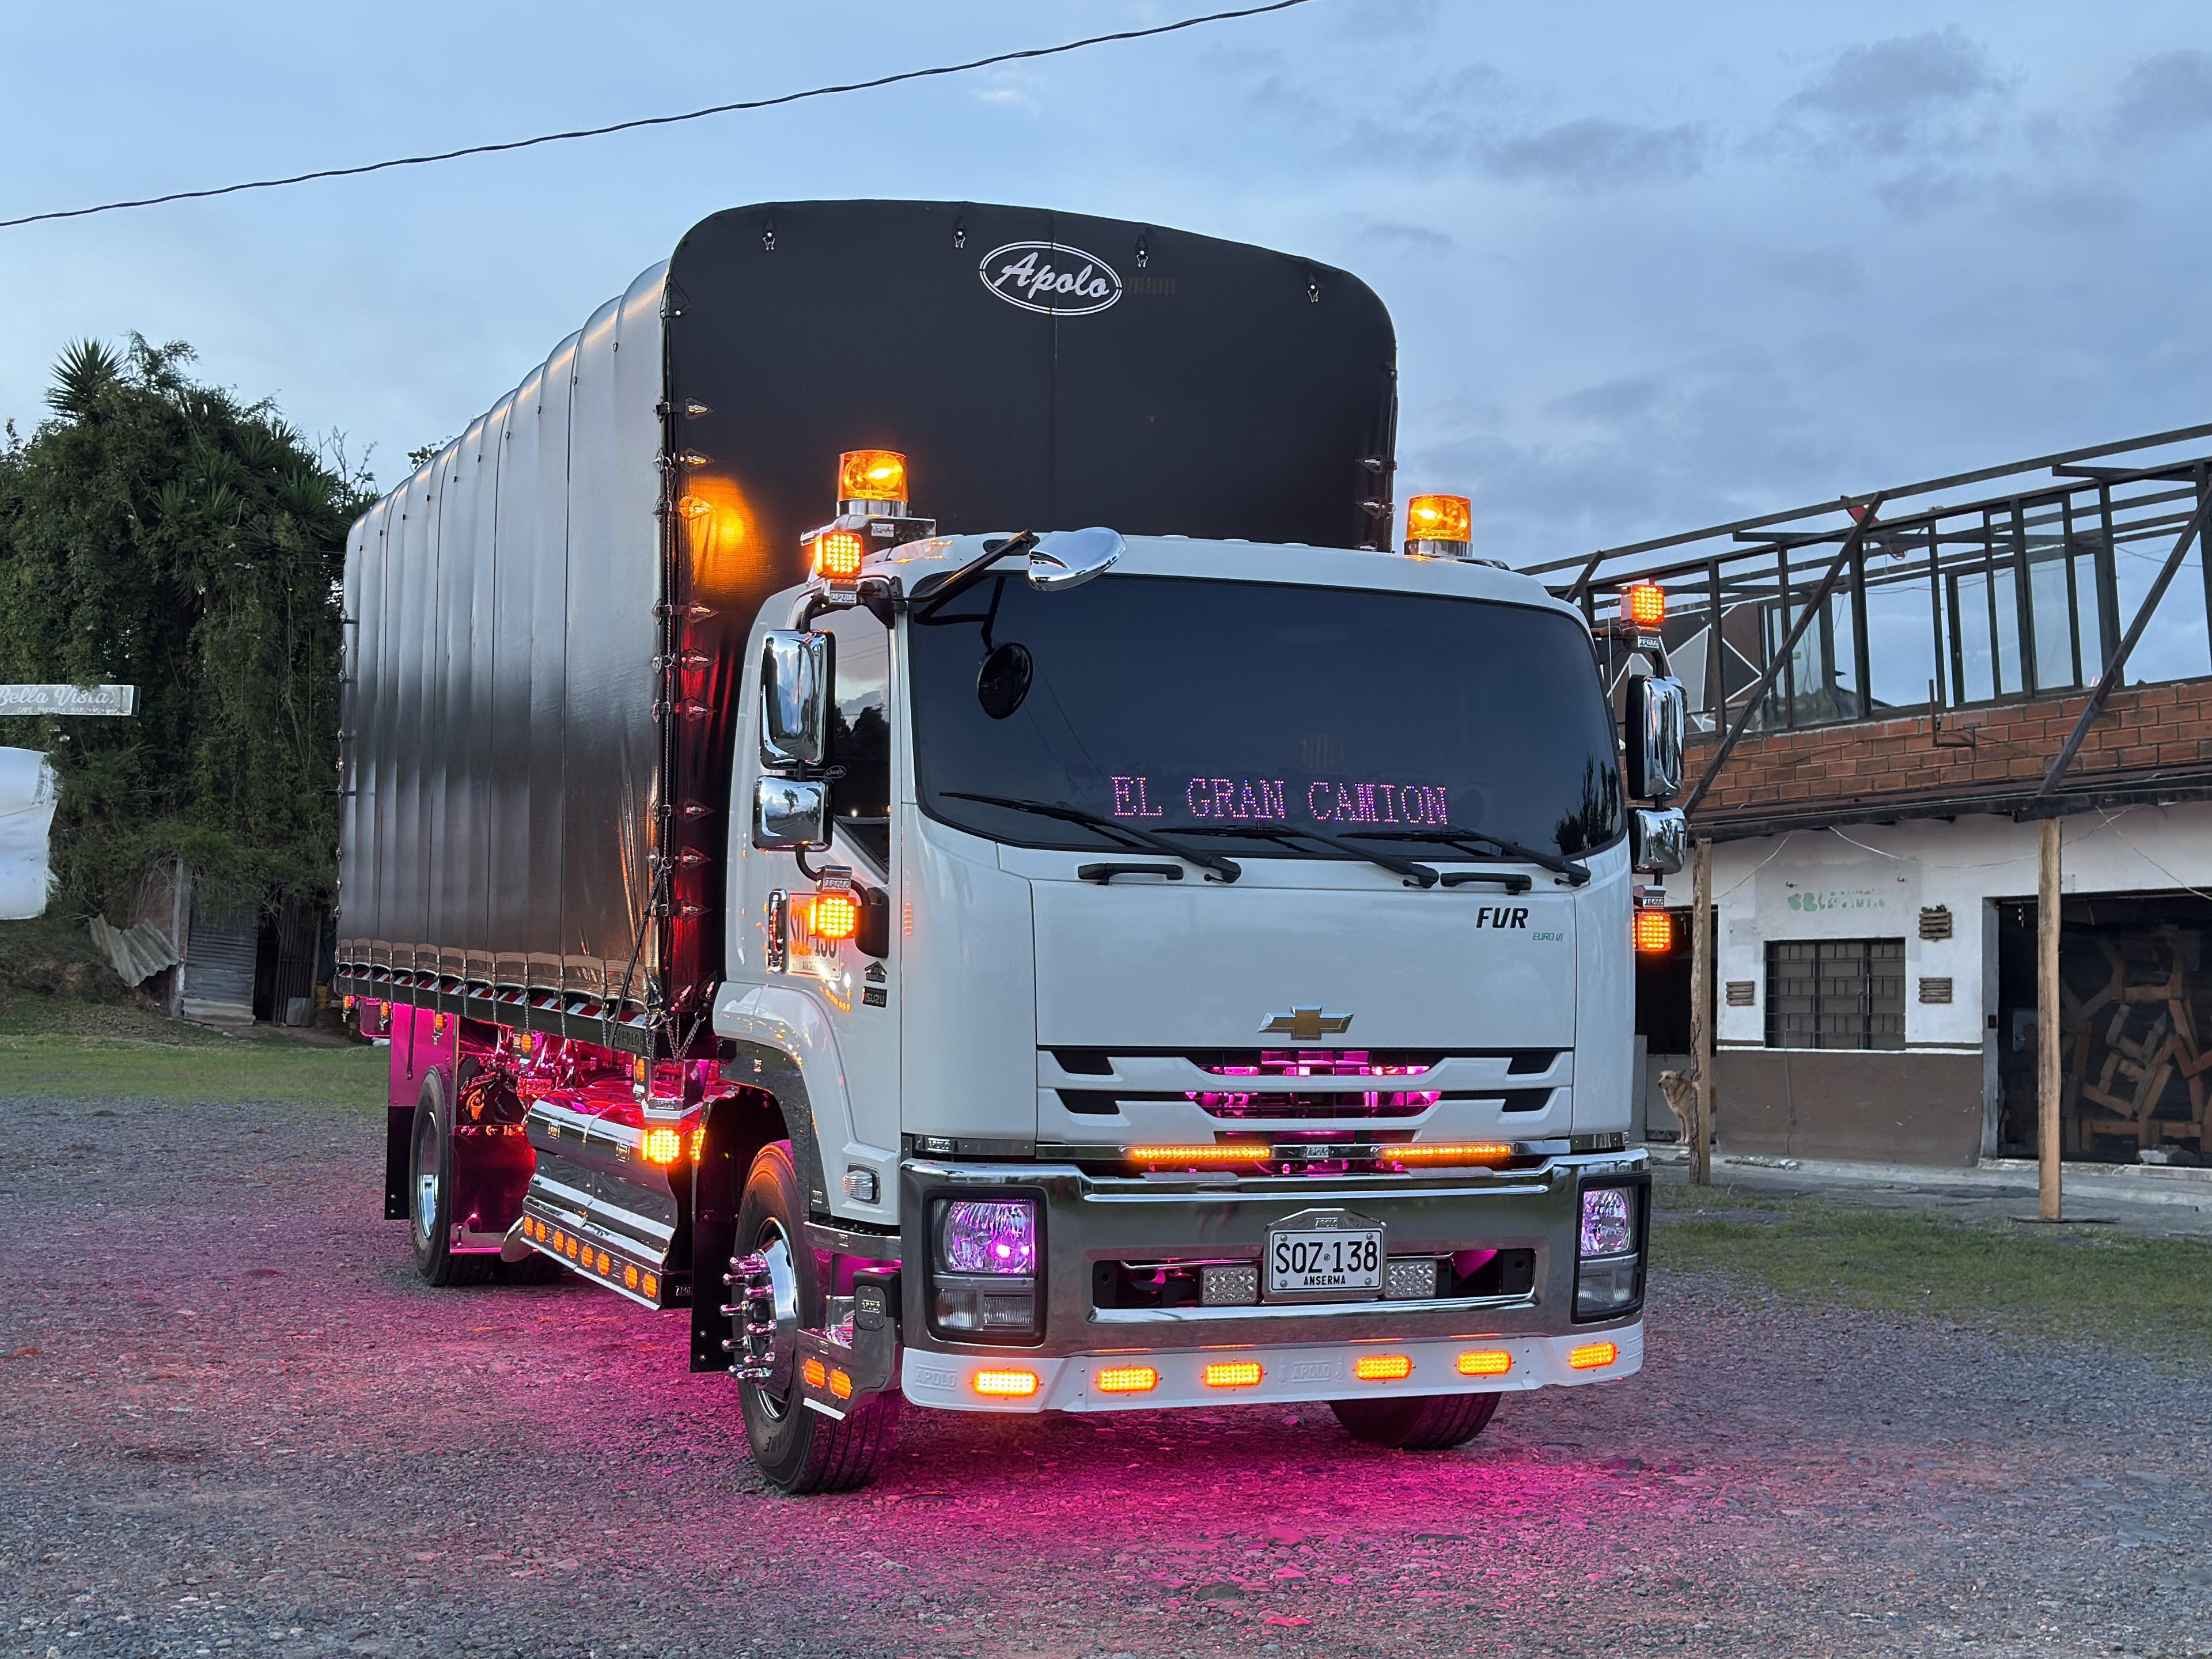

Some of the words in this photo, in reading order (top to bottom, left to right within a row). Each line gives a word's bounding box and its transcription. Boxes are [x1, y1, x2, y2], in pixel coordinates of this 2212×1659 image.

[994, 252, 1109, 300] Apolo
[0, 686, 48, 706] Bella
[1111, 777, 1163, 816] EL
[1186, 778, 1286, 820] GRAN
[1308, 782, 1447, 825] CAMION
[1476, 907, 1528, 928] FUR
[1533, 932, 1554, 941] EURO
[1332, 1241, 1377, 1272] 138
[1304, 1275, 1346, 1286] ANSERMA
